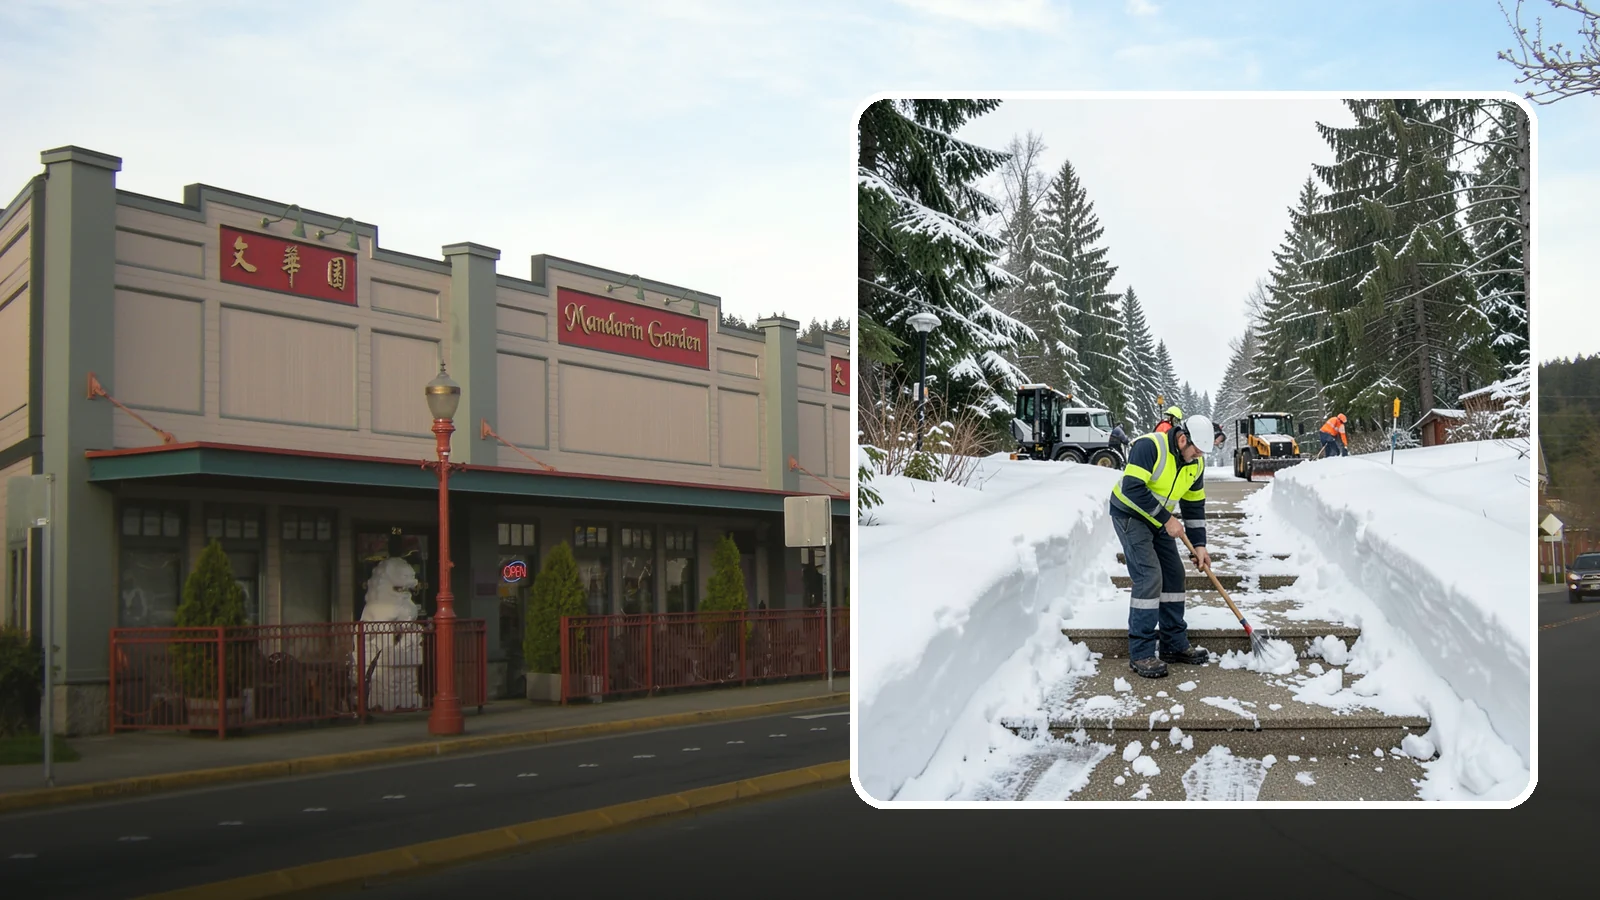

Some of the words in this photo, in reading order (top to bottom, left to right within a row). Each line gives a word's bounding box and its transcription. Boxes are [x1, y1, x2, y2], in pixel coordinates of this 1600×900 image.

[564, 302, 644, 341] Mandarin
[648, 320, 702, 352] Garden
[503, 565, 527, 578] OPEN
